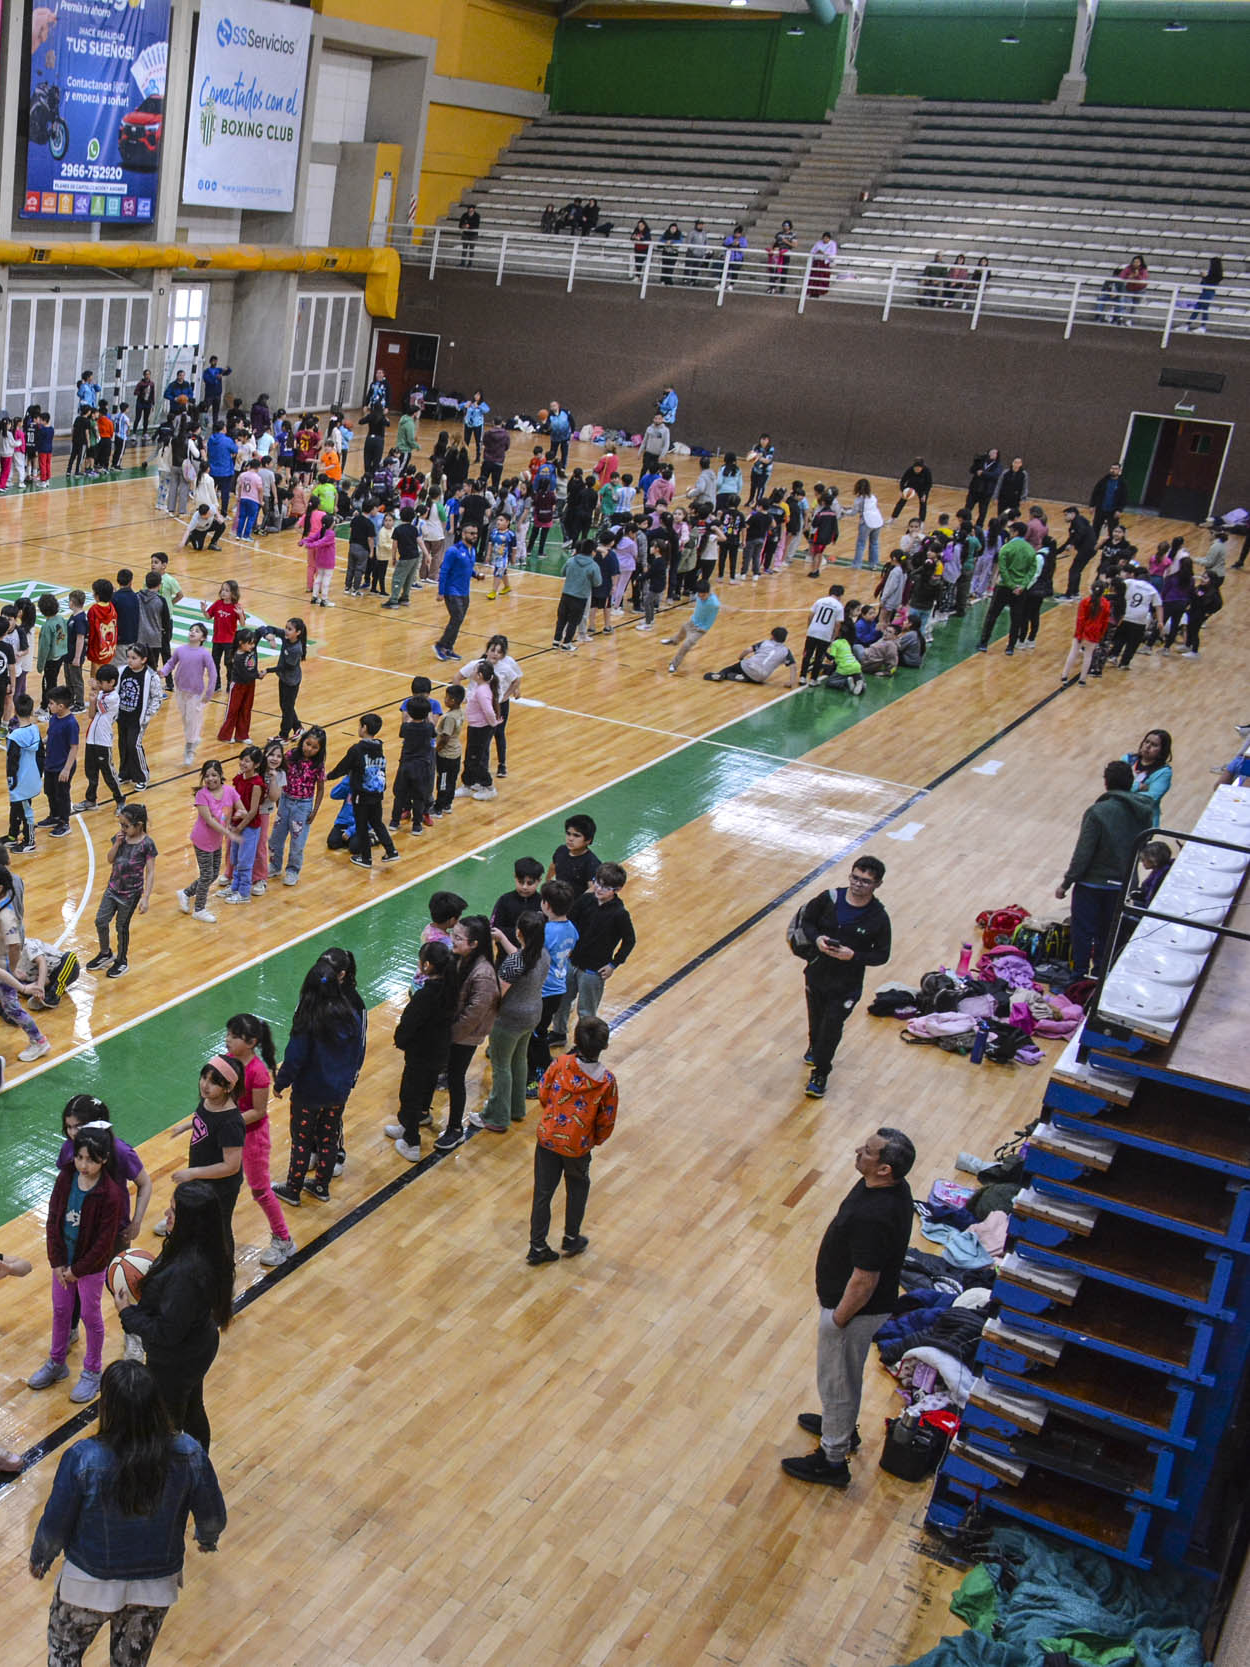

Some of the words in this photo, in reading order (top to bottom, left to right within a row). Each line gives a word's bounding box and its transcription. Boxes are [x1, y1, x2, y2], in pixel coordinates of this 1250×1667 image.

[66, 36, 88, 54] TUS
[89, 41, 135, 60] SUEÑOS!
[231, 26, 295, 55] SSServicios
[66, 75, 112, 91] Contactanos
[65, 90, 71, 102] y
[199, 70, 264, 118] Conectados
[265, 95, 284, 112] con
[285, 87, 299, 116] el
[221, 118, 263, 139] BOXING
[266, 124, 294, 142] CLUB
[60, 163, 123, 180] 2966-752920
[1130, 592, 1143, 608] 9
[815, 606, 833, 625] 10
